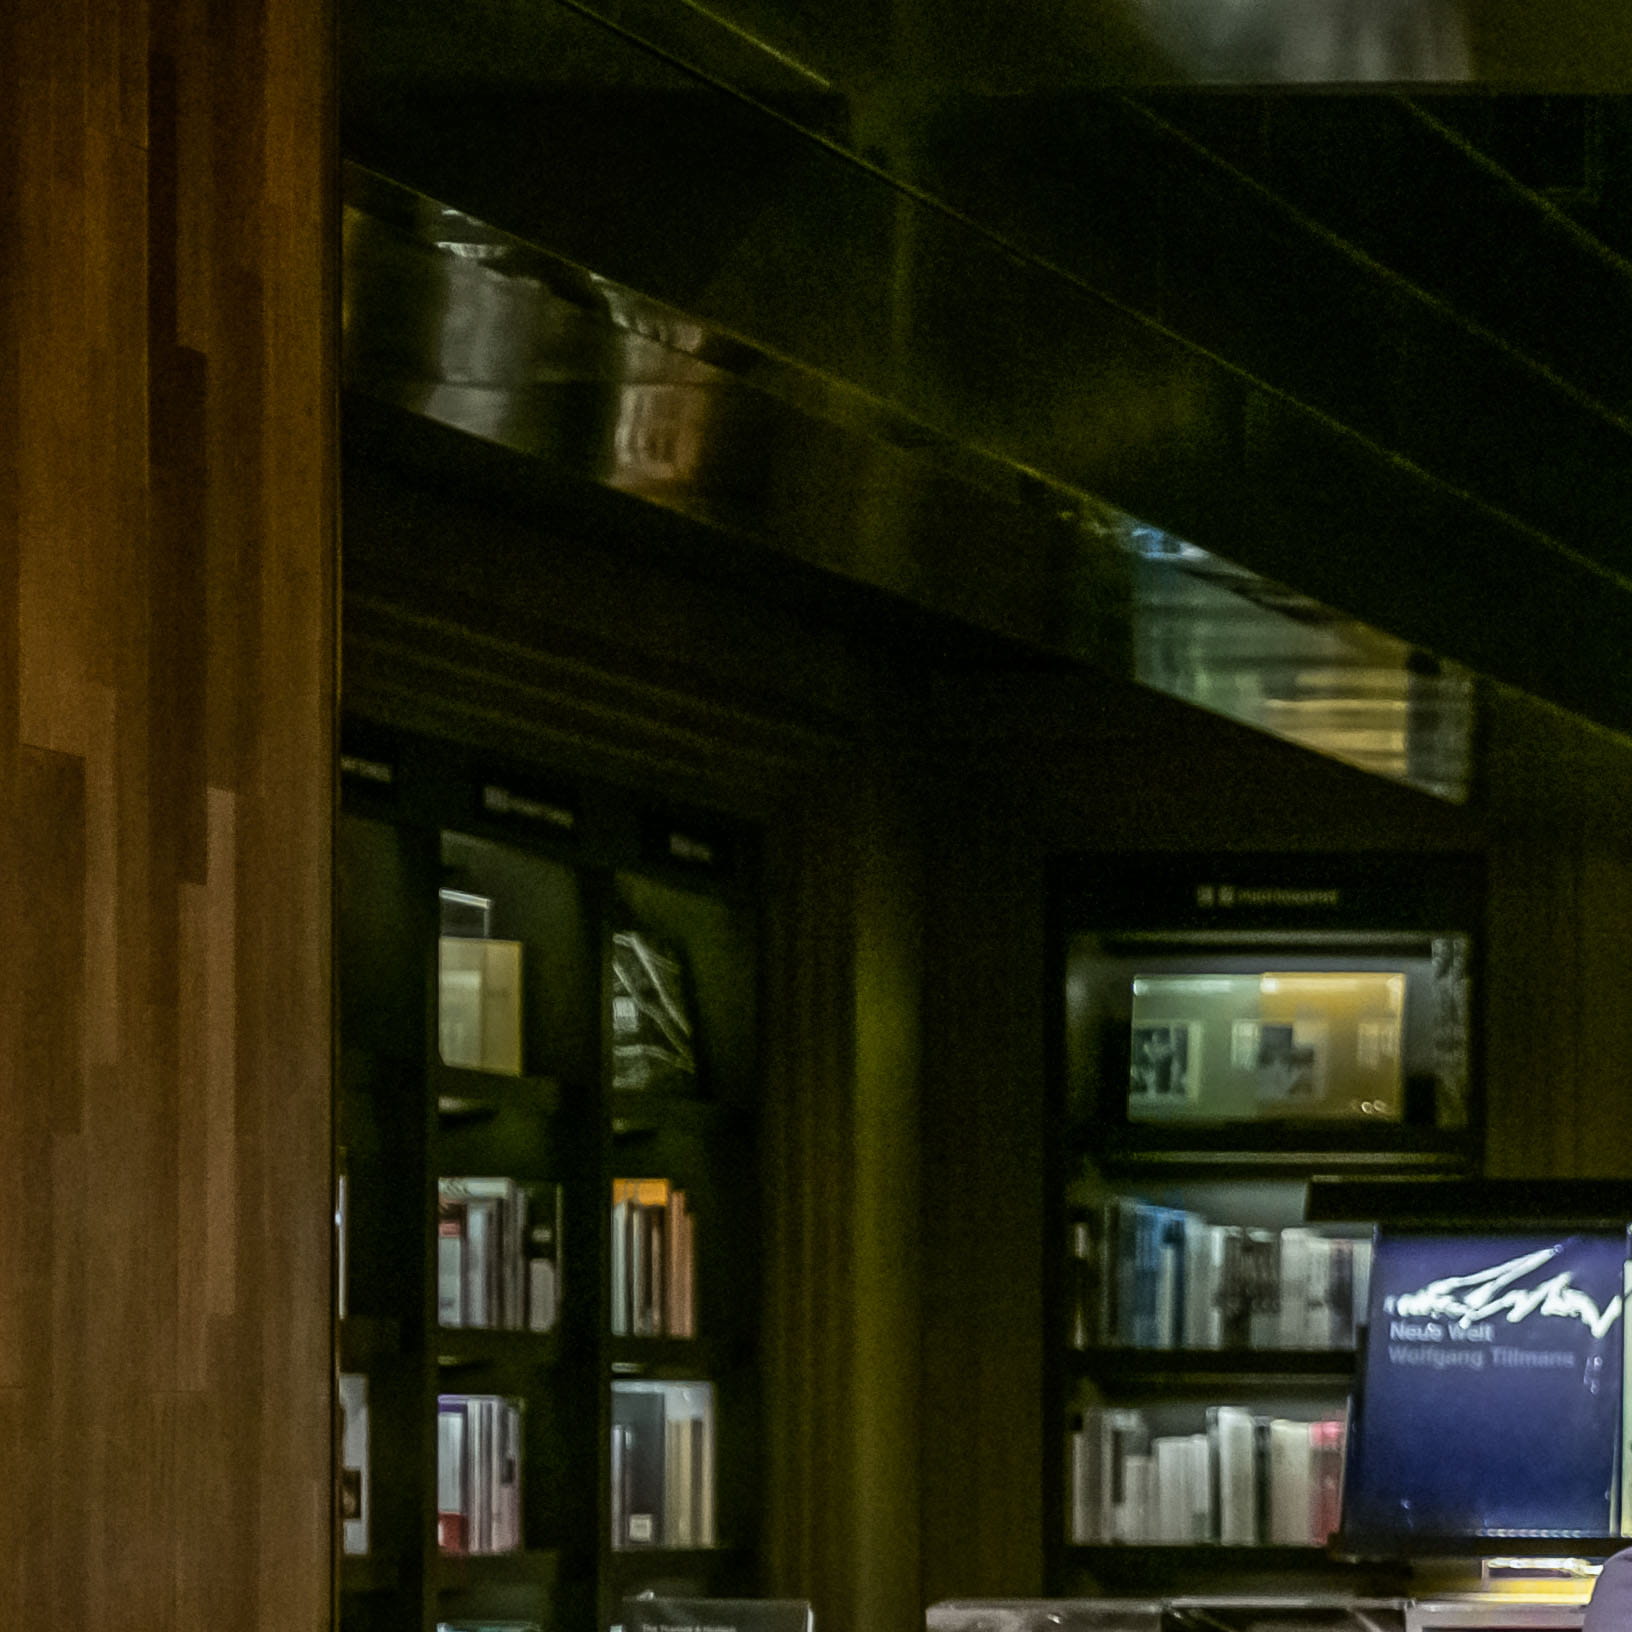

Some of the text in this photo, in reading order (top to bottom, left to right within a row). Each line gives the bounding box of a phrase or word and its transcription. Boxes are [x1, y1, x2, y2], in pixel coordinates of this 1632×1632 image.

[1389, 1321, 1495, 1342] Neue Welt
[1388, 1345, 1576, 1370] Wolfgang Tillmans
